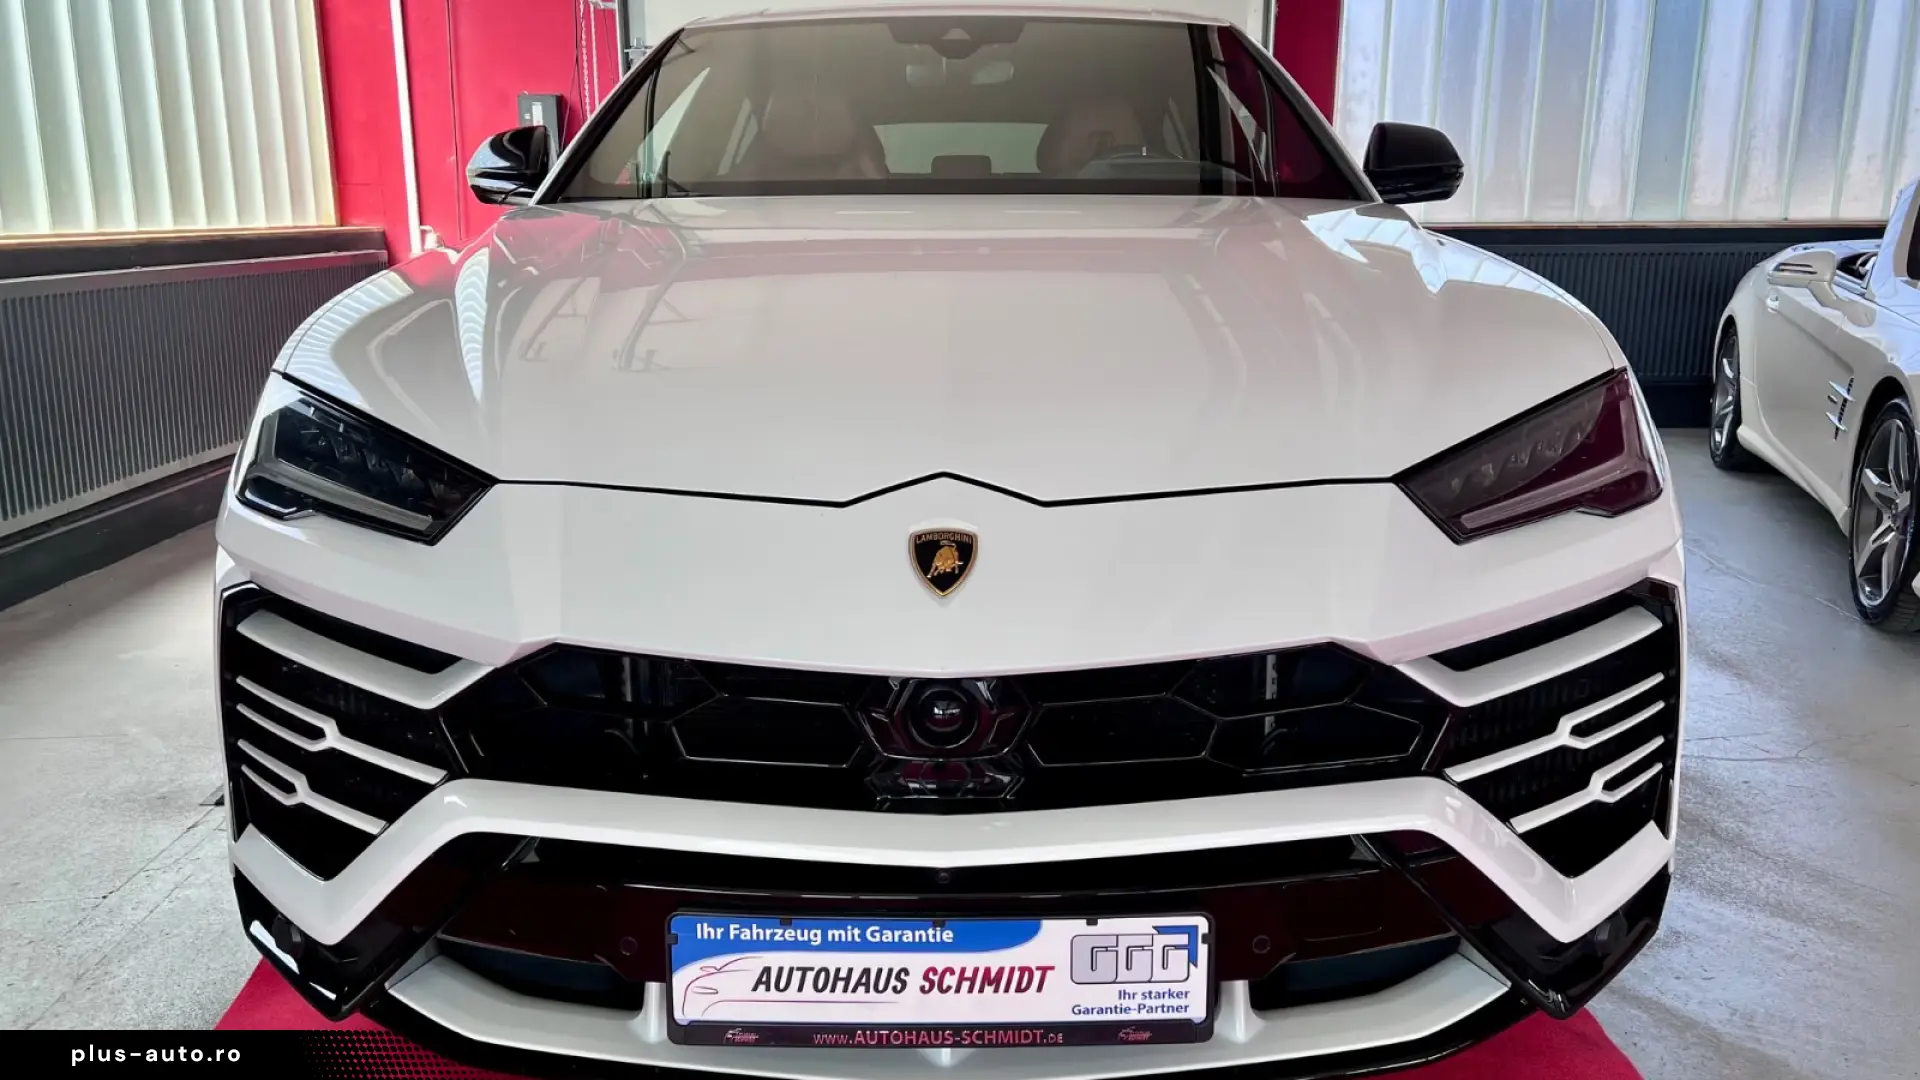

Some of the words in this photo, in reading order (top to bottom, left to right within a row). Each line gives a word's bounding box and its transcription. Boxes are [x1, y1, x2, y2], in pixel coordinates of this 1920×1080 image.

[916, 532, 972, 544] LAMBORGHINI
[696, 923, 724, 940] Ihr
[729, 924, 822, 946] Fahrzeug
[827, 925, 861, 943] mit
[866, 925, 954, 943] Garantie
[751, 966, 910, 995] AUTOHAUS
[919, 965, 1055, 995] SCHMIDT
[1118, 989, 1138, 1000] Ihr
[1141, 988, 1190, 1000] starker
[1071, 1002, 1190, 1016] Garantie-Partner
